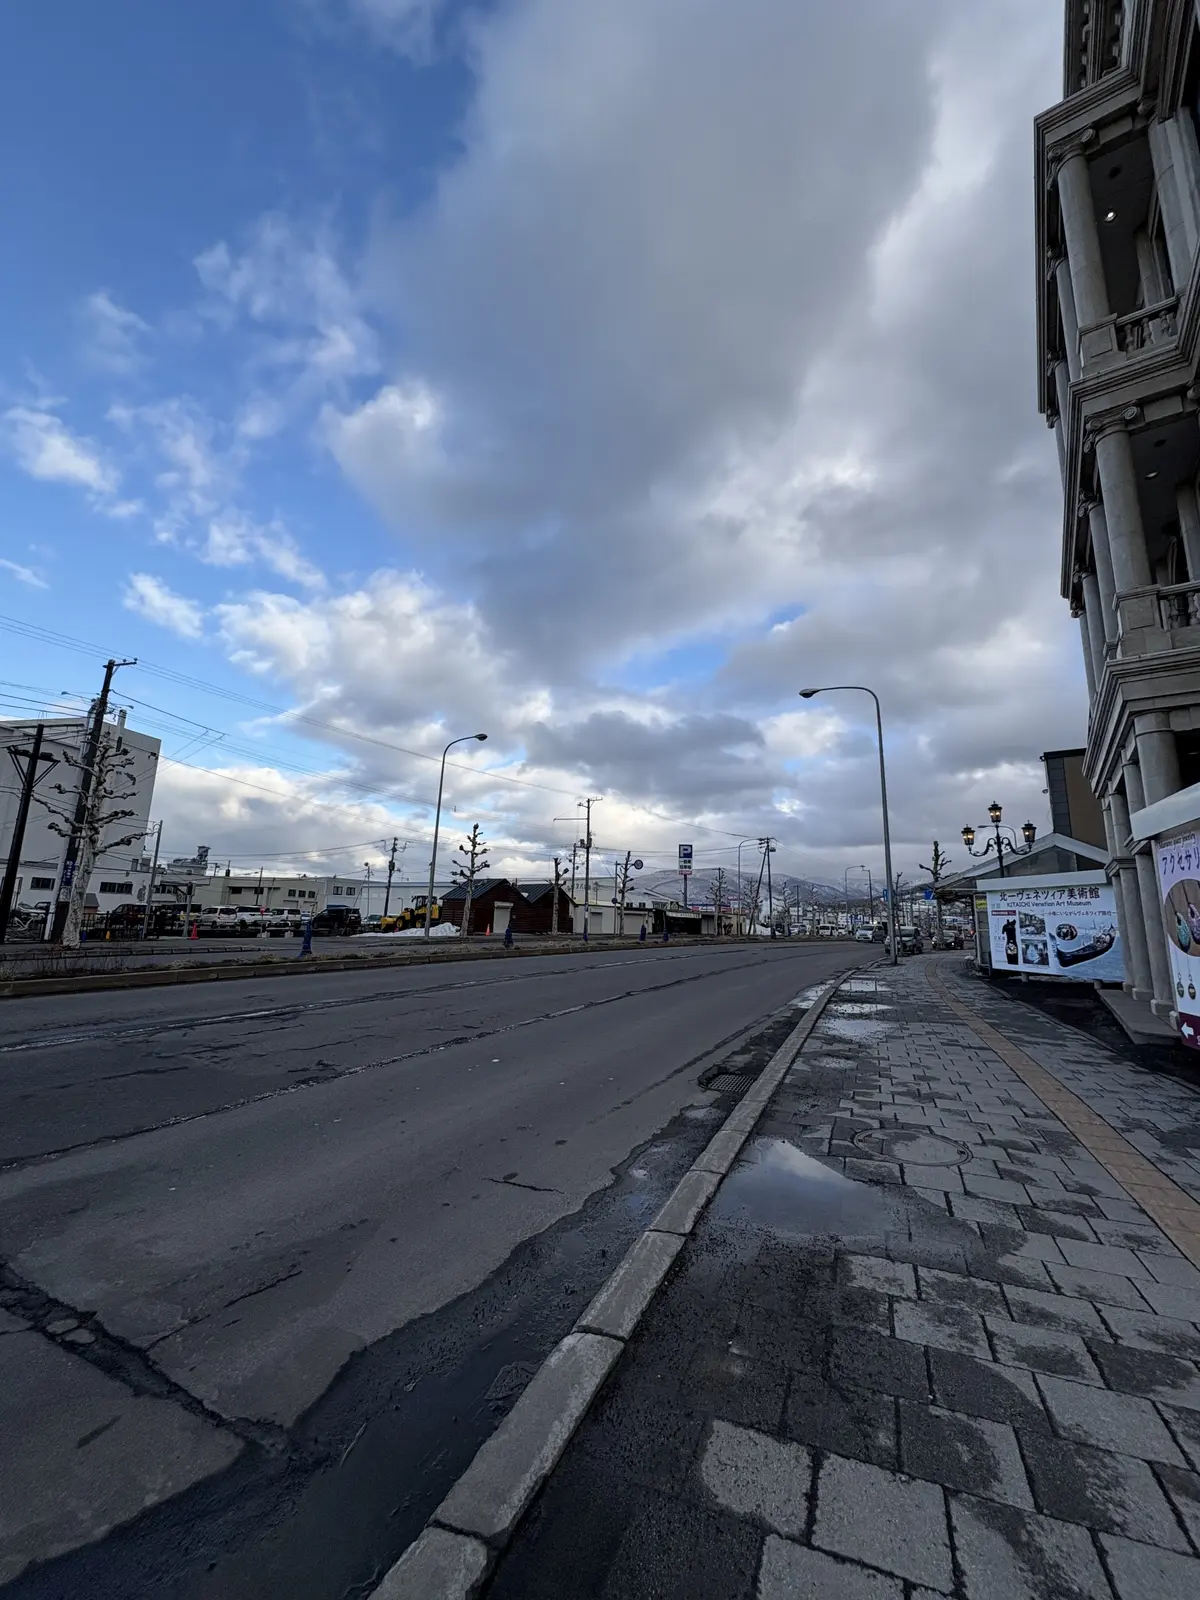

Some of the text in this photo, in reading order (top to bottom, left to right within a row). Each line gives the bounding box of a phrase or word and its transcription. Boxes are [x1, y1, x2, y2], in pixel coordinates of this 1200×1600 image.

[680, 846, 691, 857] P
[1000, 886, 1100, 902] 北一ヴェネツィア美術館
